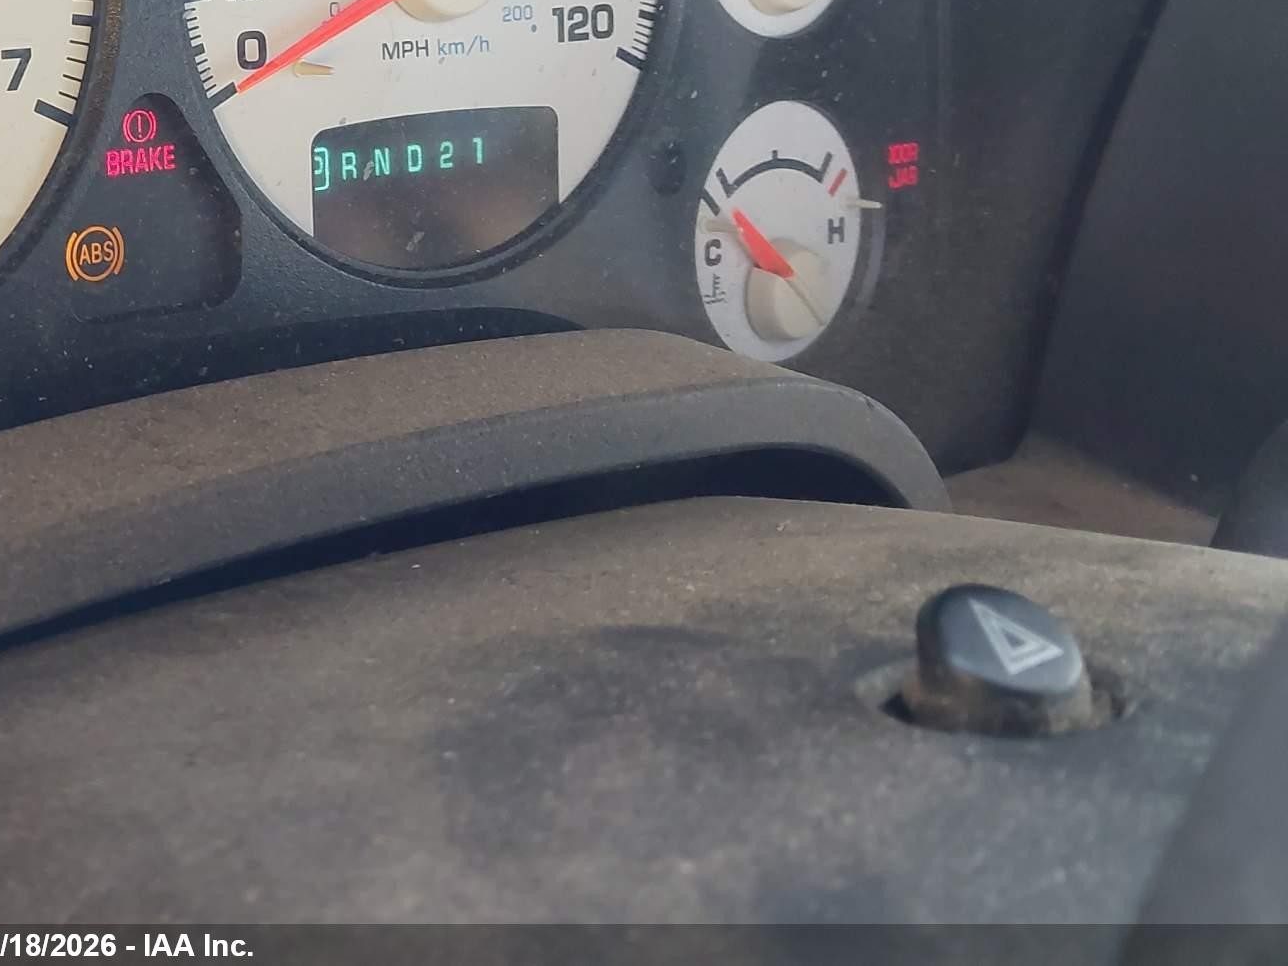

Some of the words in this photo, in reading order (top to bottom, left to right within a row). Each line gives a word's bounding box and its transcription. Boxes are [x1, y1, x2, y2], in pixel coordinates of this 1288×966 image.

[502, 4, 533, 23] 200
[551, 3, 615, 43] 120
[236, 30, 268, 70] 0
[381, 39, 429, 61] MPH
[437, 35, 490, 56] km/h
[0, 47, 32, 92] 7
[106, 145, 176, 176] BRAKE
[341, 152, 357, 180] R
[374, 148, 390, 176] N
[407, 144, 422, 172] D
[440, 141, 454, 169] 2
[473, 137, 484, 164] 1
[827, 216, 845, 245] H
[79, 241, 113, 266] ABS
[704, 238, 722, 267] C
